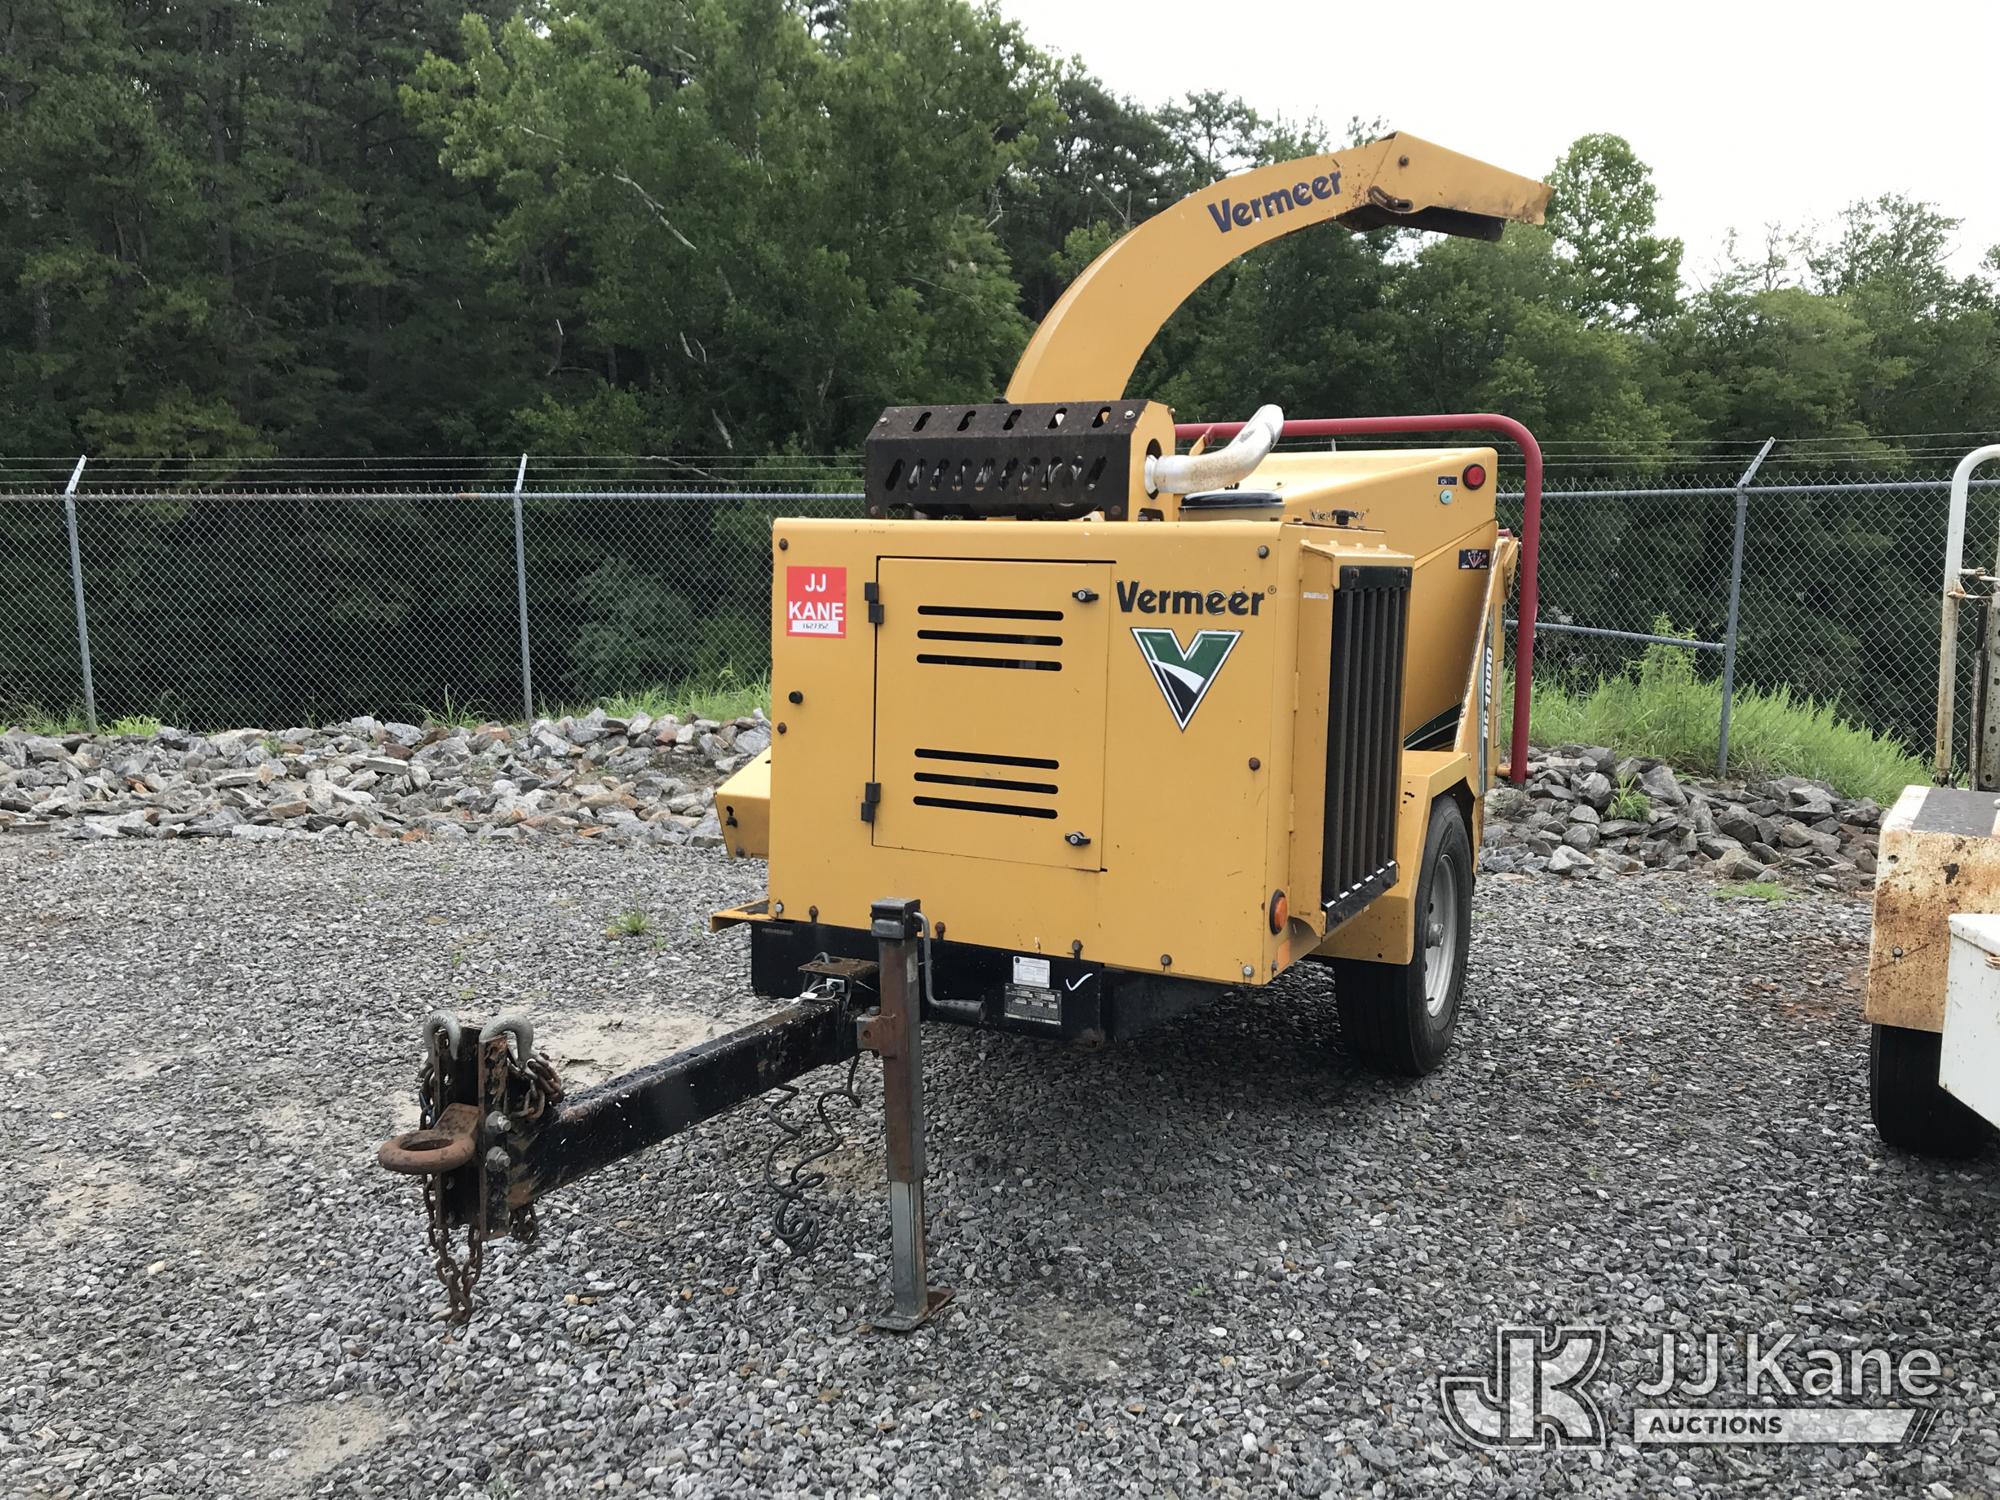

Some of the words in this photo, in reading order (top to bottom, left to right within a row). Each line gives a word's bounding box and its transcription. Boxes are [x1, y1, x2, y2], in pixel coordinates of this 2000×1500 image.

[1207, 171, 1342, 233] Vermeer
[1310, 509, 1365, 521] Verer
[804, 573, 827, 592] JJ
[1116, 580, 1265, 616] Vermeer
[788, 601, 844, 621] KANE
